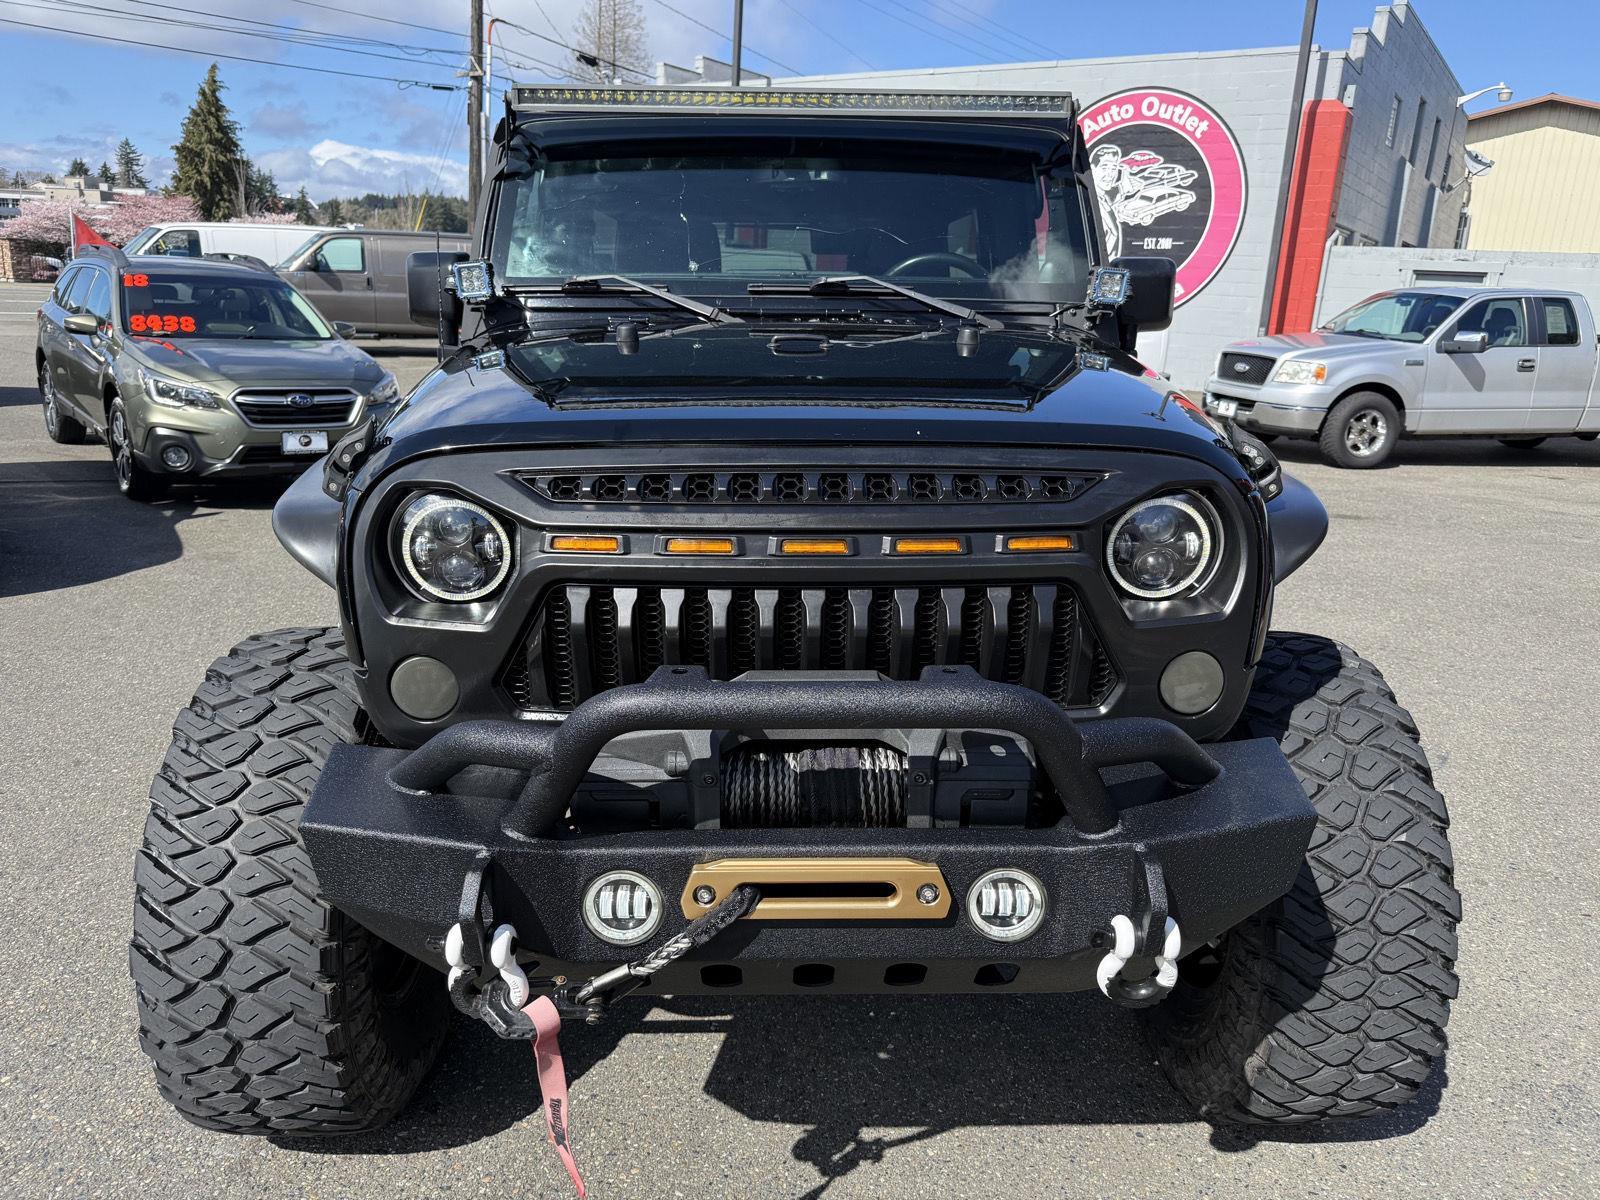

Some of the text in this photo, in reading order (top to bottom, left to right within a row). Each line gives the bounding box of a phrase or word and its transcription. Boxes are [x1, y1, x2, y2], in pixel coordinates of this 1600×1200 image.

[1083, 96, 1210, 139] Auto Outlet
[123, 273, 149, 287] 18
